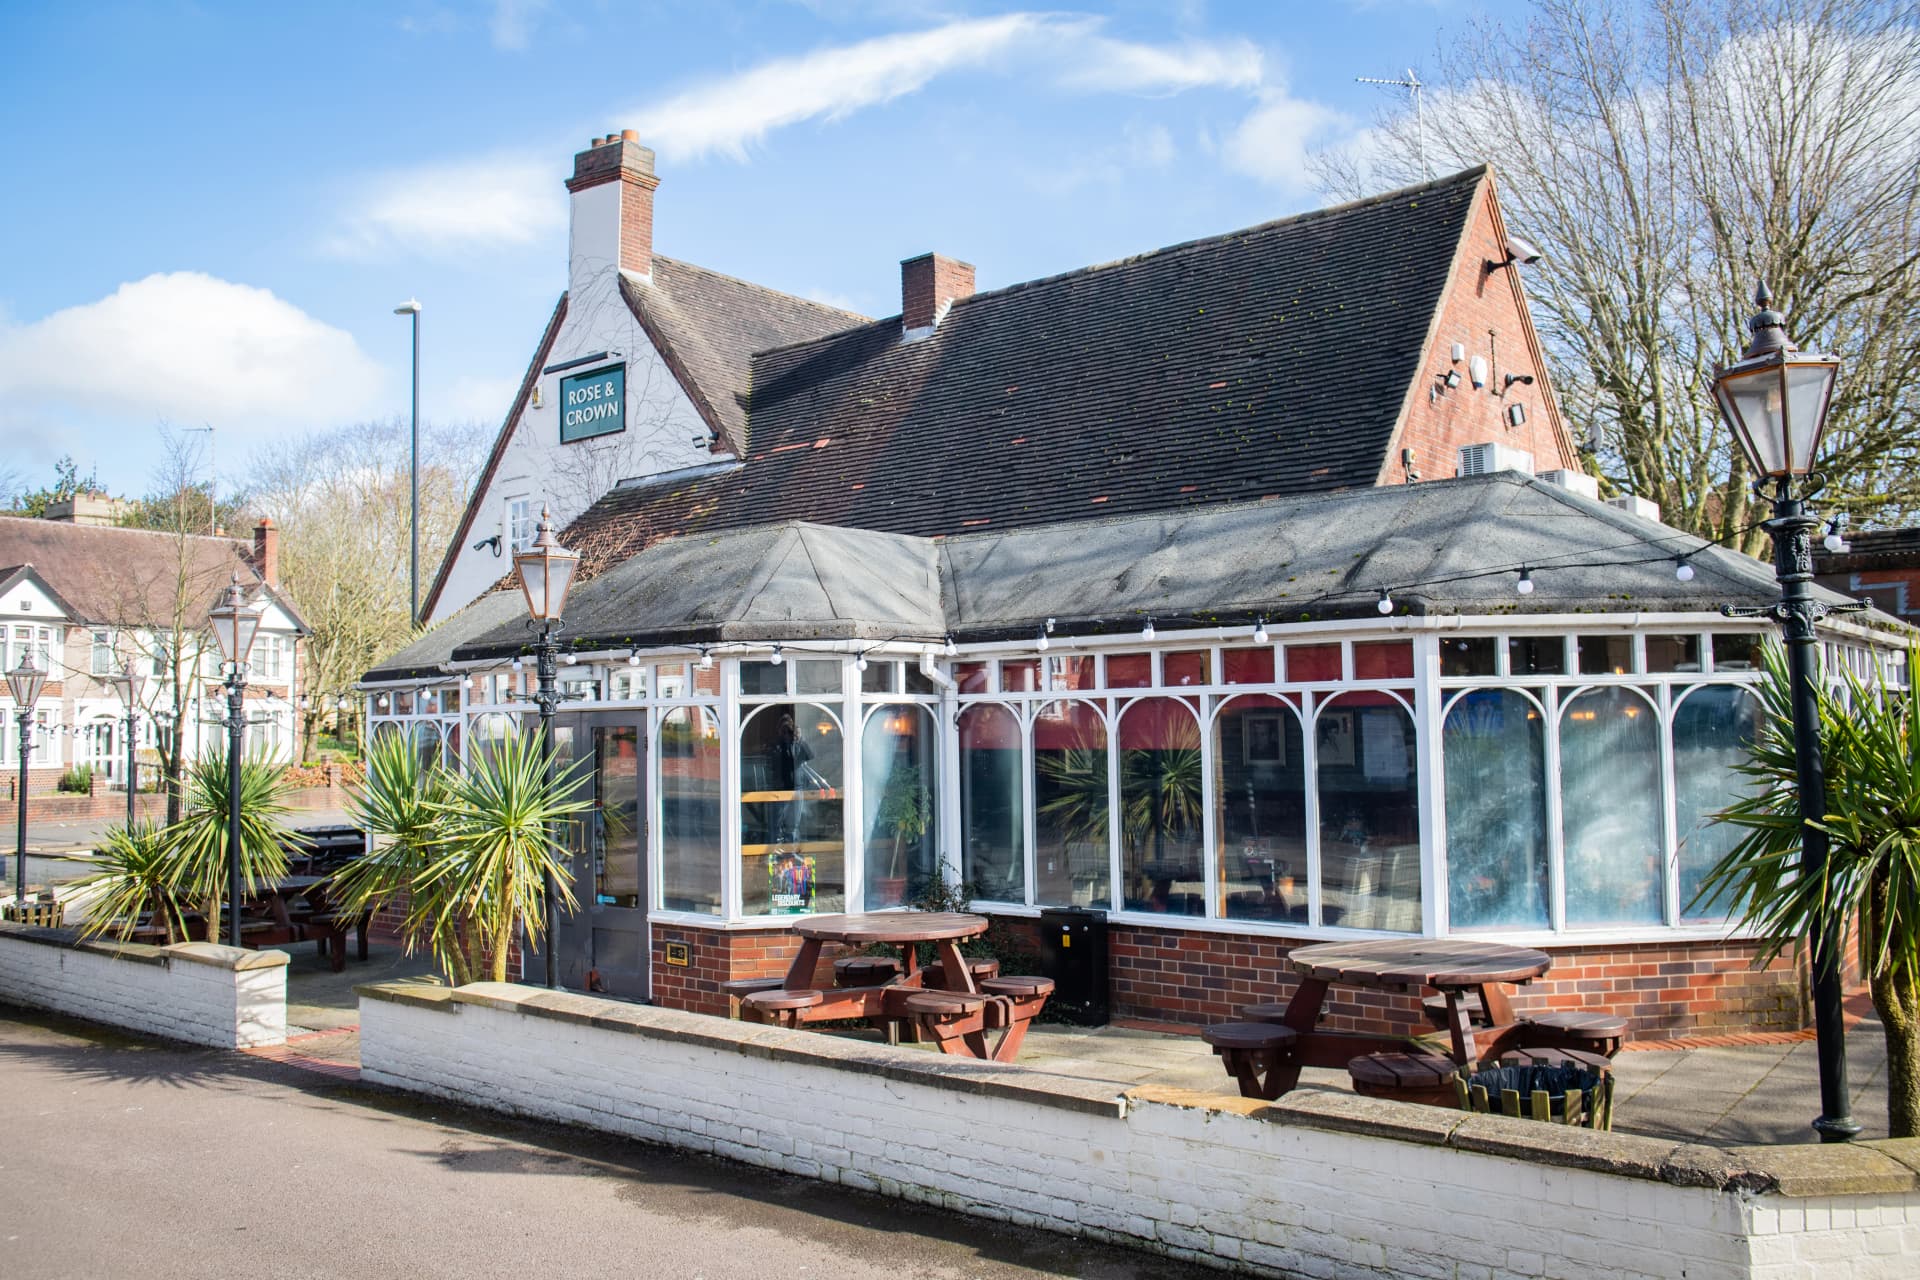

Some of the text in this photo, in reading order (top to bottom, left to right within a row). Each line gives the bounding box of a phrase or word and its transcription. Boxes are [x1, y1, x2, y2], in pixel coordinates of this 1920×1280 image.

[569, 381, 615, 405] ROSE &
[566, 401, 619, 426] CROWN
